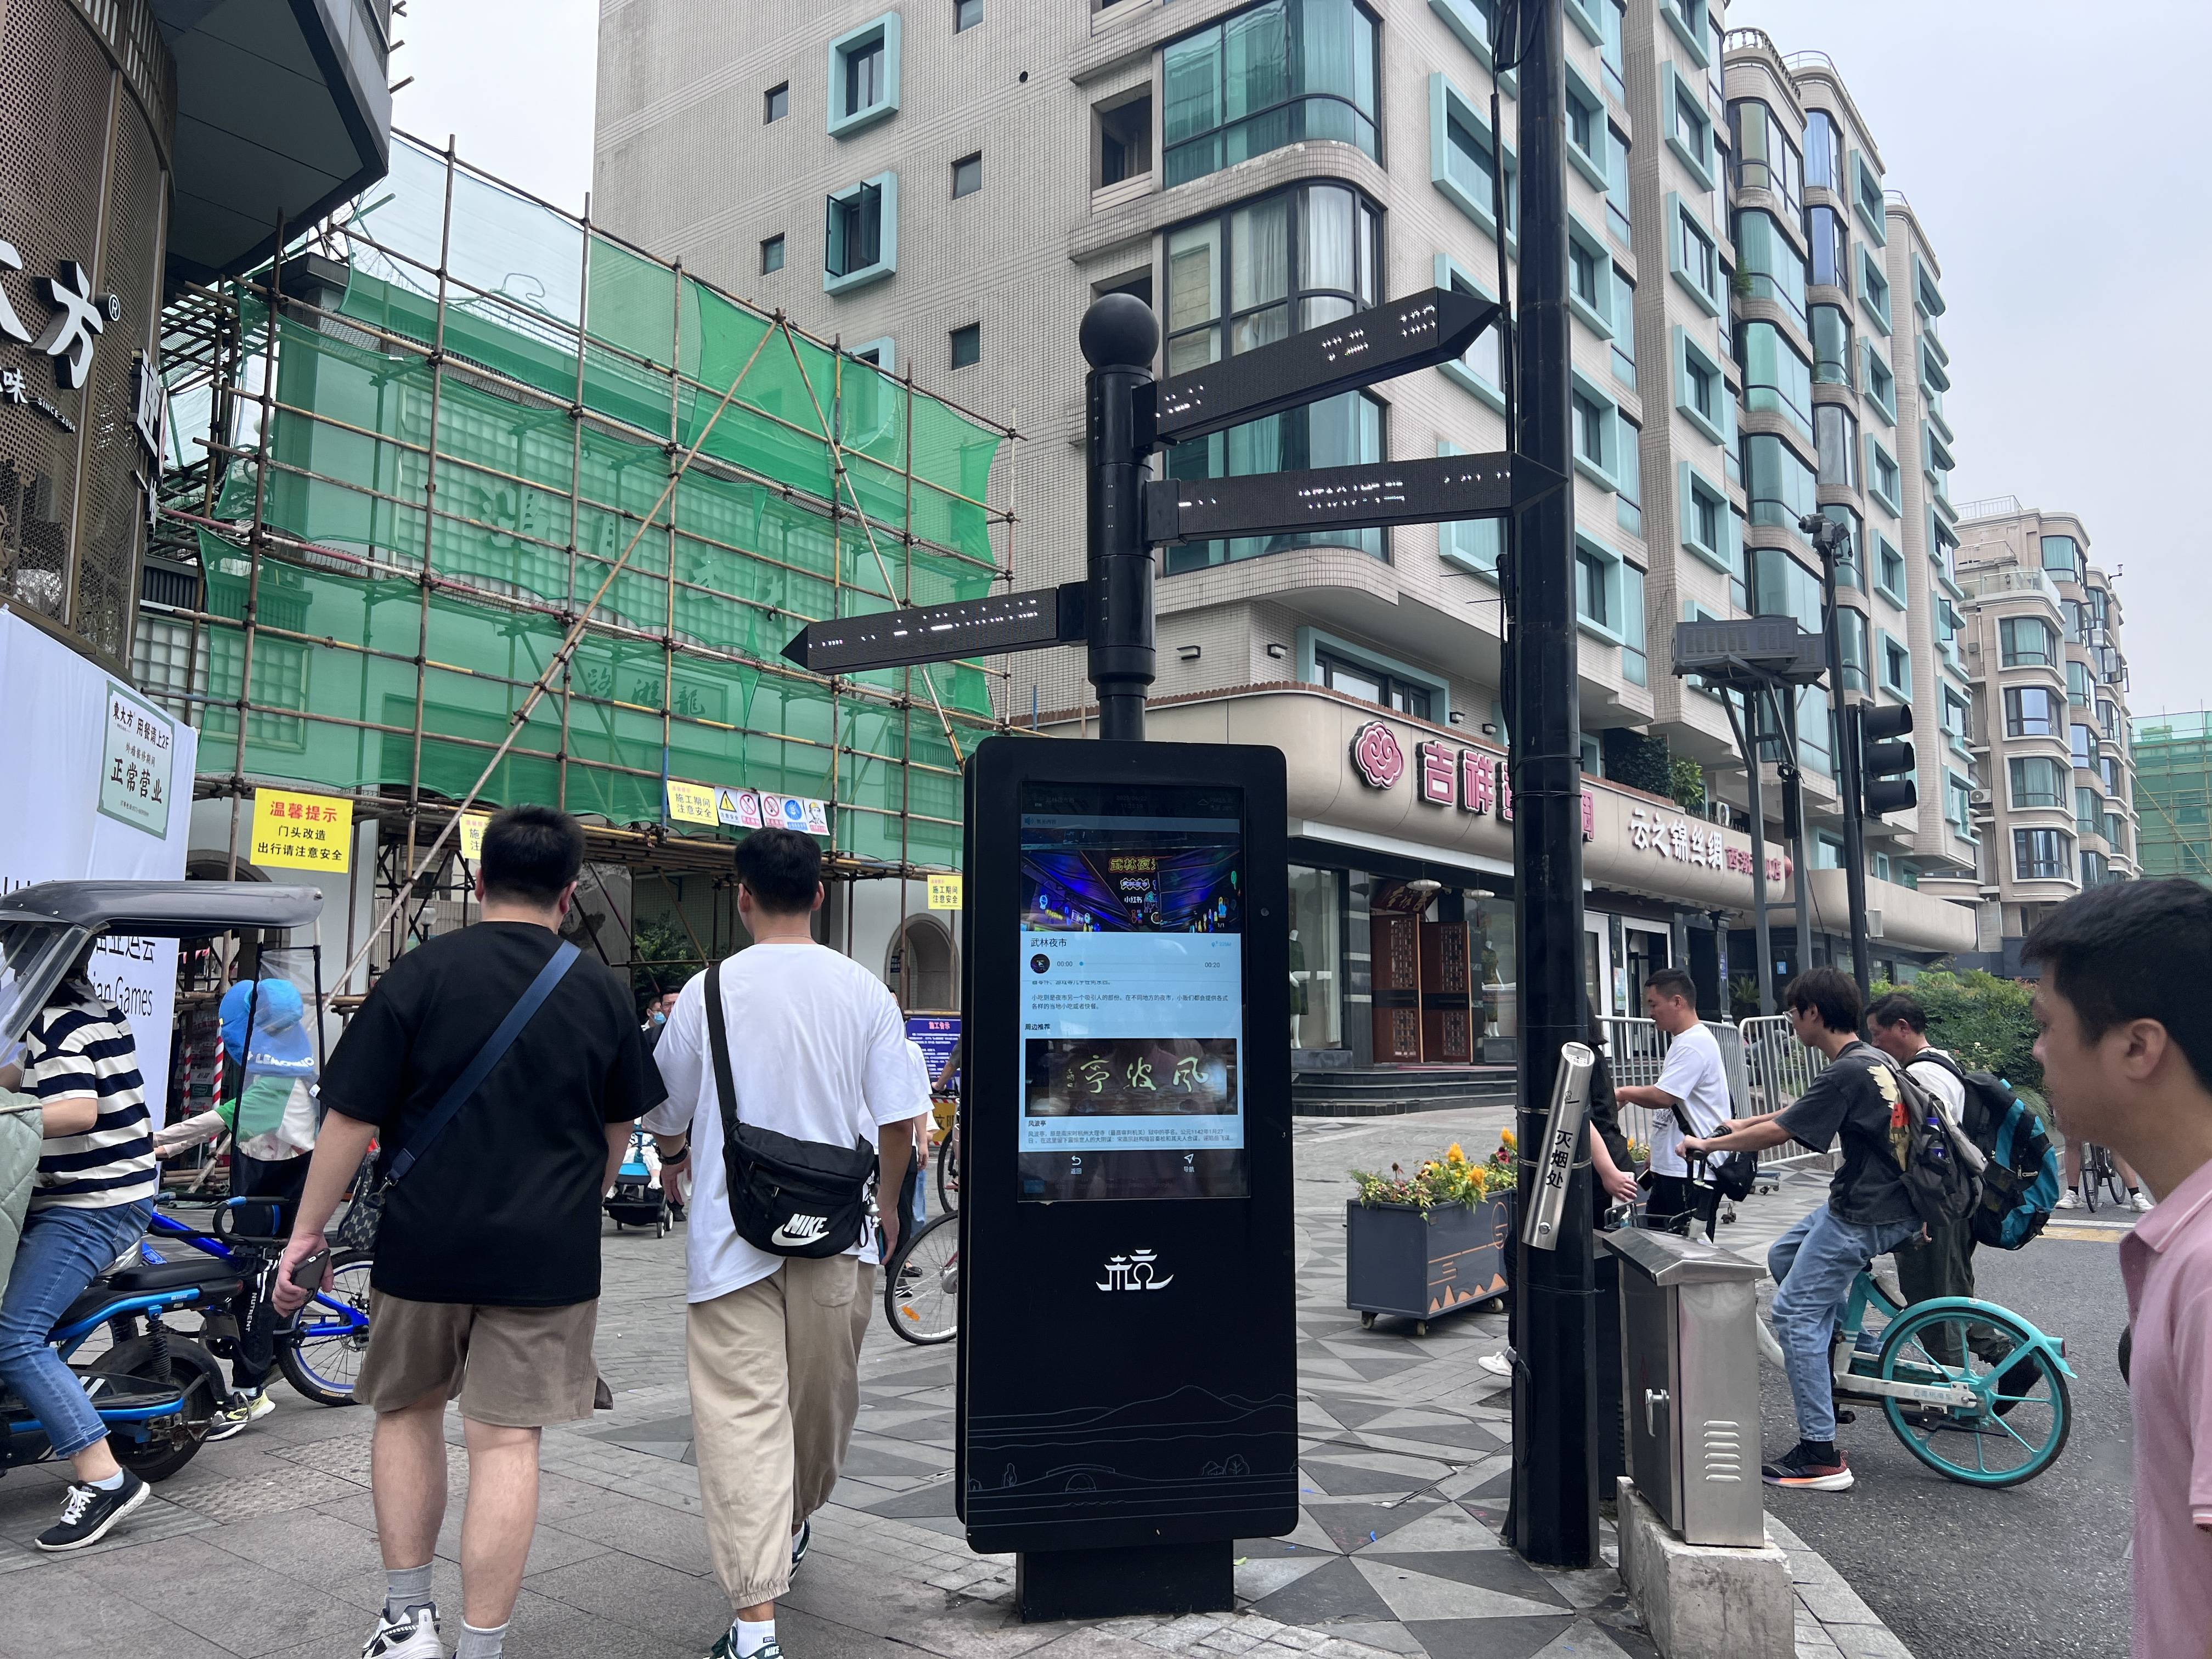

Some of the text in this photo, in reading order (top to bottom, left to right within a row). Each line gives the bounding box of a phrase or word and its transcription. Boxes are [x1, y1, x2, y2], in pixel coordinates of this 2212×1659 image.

[37, 397, 76, 433] SINCE 2004
[137, 718, 170, 750] 用餐请上2F
[110, 756, 162, 804] 正常营业
[675, 793, 710, 808] 施工期间
[270, 801, 338, 823] 温馨提示
[677, 803, 712, 818] 注意安全
[278, 825, 325, 841] 门头改造
[258, 842, 342, 861] 出行请注意安全
[933, 885, 957, 895] 施工期间
[933, 895, 957, 904] 注意安全
[1030, 938, 1067, 948] 武林夜市
[115, 976, 153, 1016] Games
[1545, 1129, 1574, 1189] 灭烟处
[783, 1213, 828, 1237] NIKE
[764, 1645, 780, 1658] NIKE
